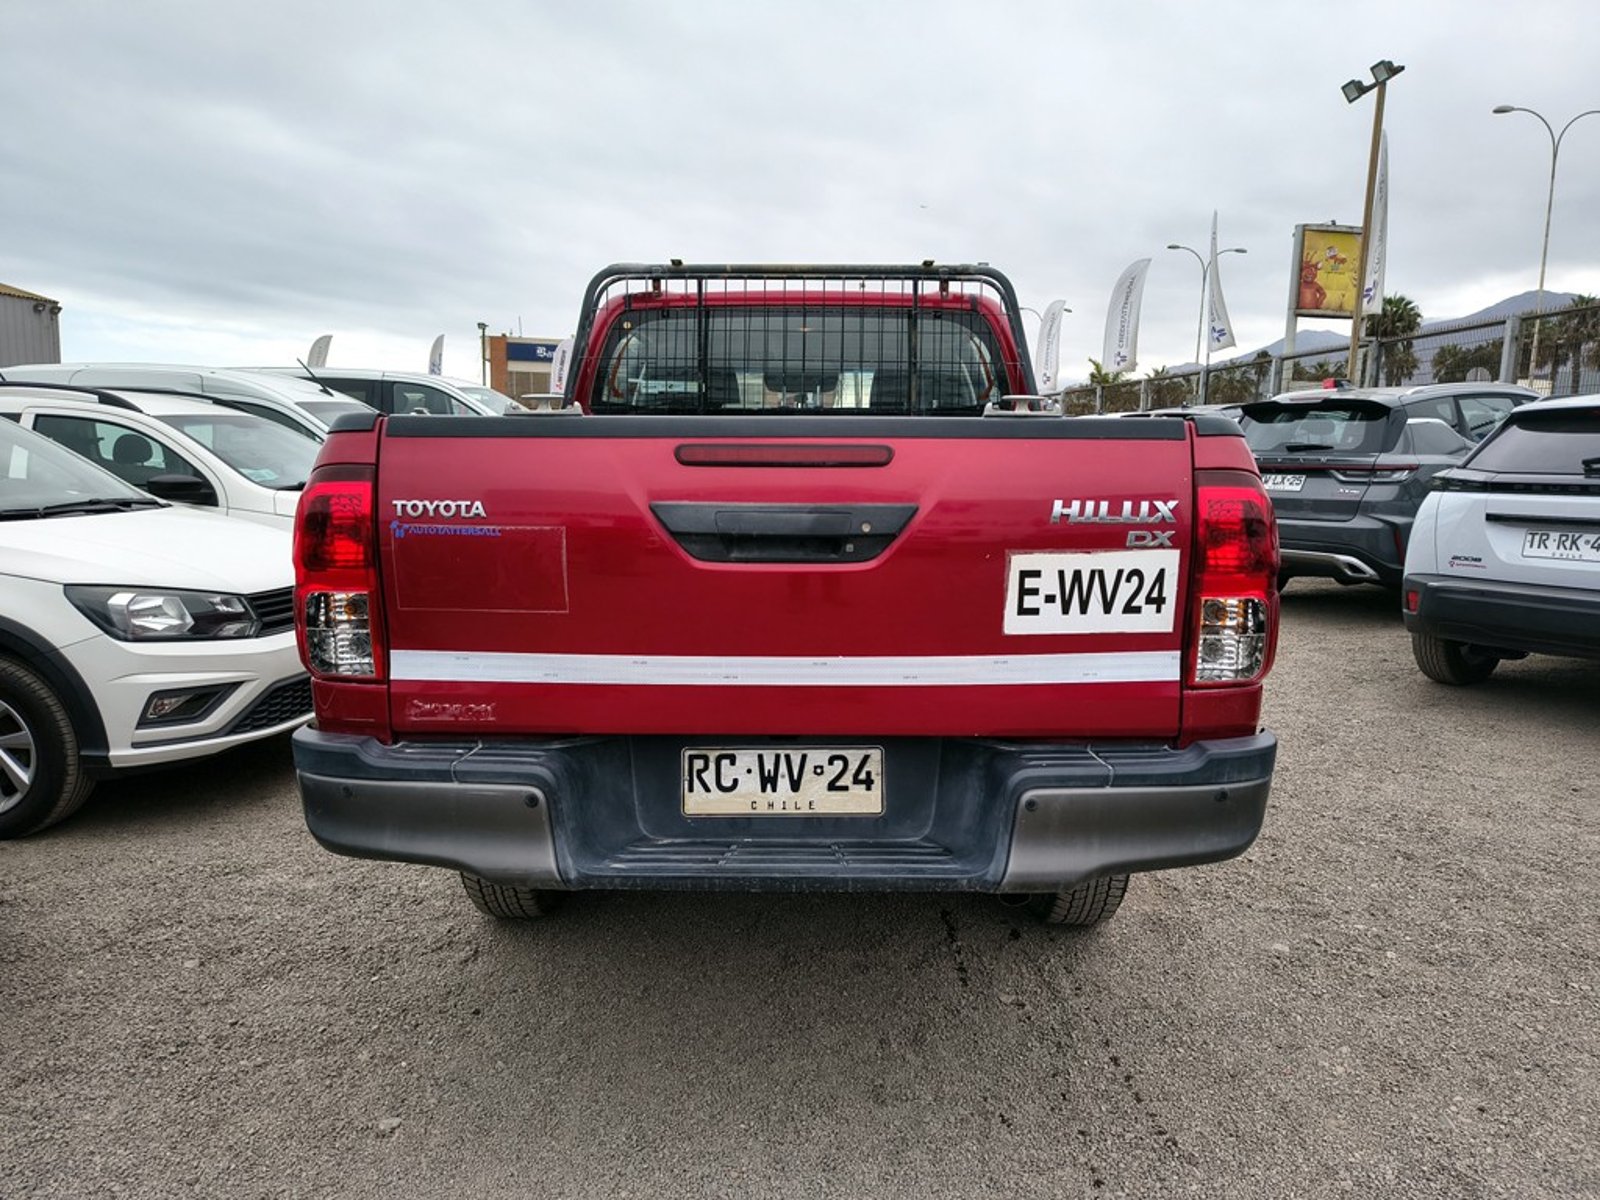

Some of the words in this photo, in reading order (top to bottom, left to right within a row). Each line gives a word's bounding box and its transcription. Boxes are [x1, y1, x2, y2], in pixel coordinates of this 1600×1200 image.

[392, 500, 487, 518] TOYOTA
[1051, 499, 1179, 523] HILUX
[1126, 530, 1176, 548] DX
[1017, 568, 1167, 616] E-WV24
[751, 800, 816, 810] CHILE
